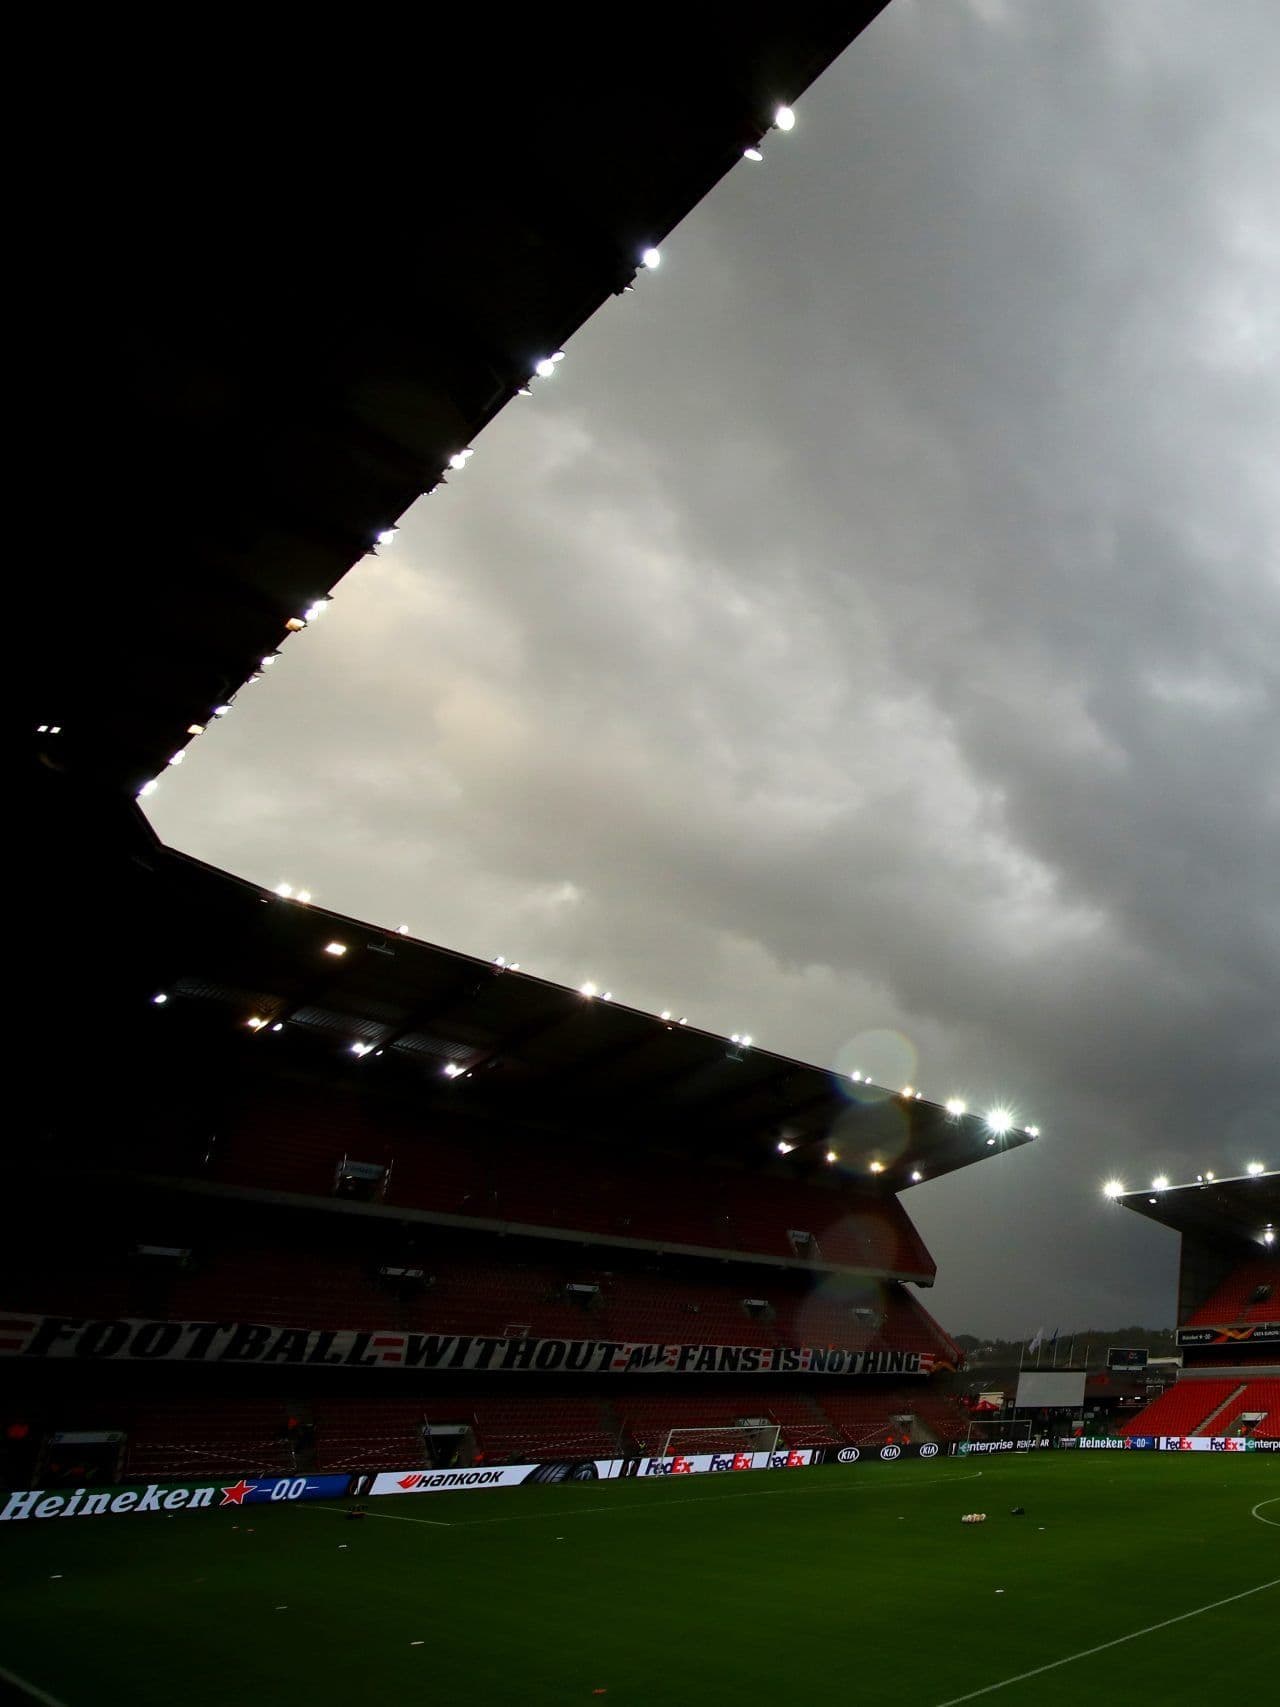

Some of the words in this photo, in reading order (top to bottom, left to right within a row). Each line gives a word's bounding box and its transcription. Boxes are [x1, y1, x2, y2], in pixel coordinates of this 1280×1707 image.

[22, 1317, 378, 1367] FOOTBALL
[404, 1334, 624, 1371] WITHOUT
[626, 1344, 668, 1372] ALL
[676, 1345, 761, 1372] FANS
[771, 1348, 801, 1372] IS
[808, 1349, 920, 1374] NOTHING
[959, 1438, 1014, 1451] enterprise
[1079, 1436, 1123, 1449] Heineken
[1166, 1437, 1193, 1450] FedEx
[1210, 1437, 1239, 1451] FedEx
[645, 1456, 694, 1475] FedEx
[709, 1452, 752, 1472] FedEx
[0, 1484, 216, 1520] Heineken
